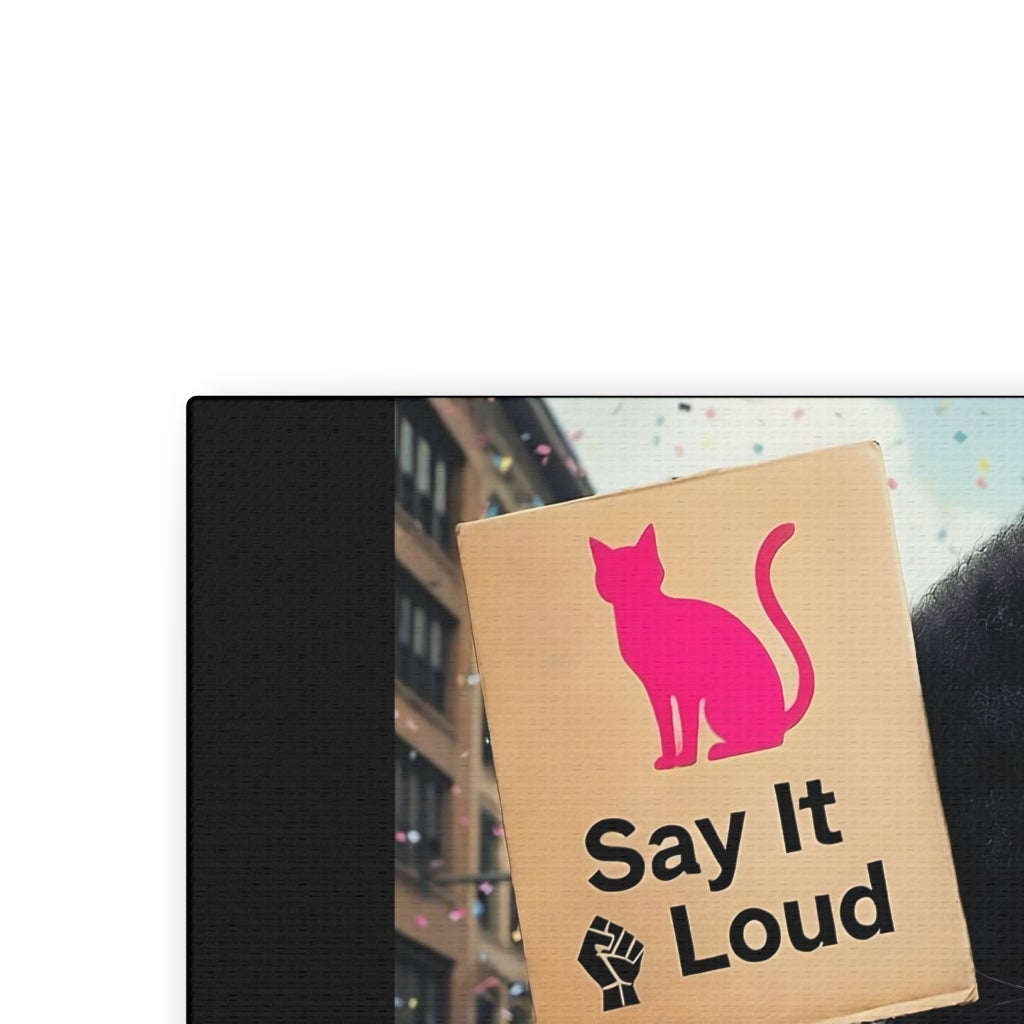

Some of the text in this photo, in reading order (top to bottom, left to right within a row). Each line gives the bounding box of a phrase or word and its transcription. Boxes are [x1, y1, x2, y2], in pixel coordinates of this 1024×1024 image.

[585, 779, 843, 892] Say It
[670, 860, 895, 977] Loud
